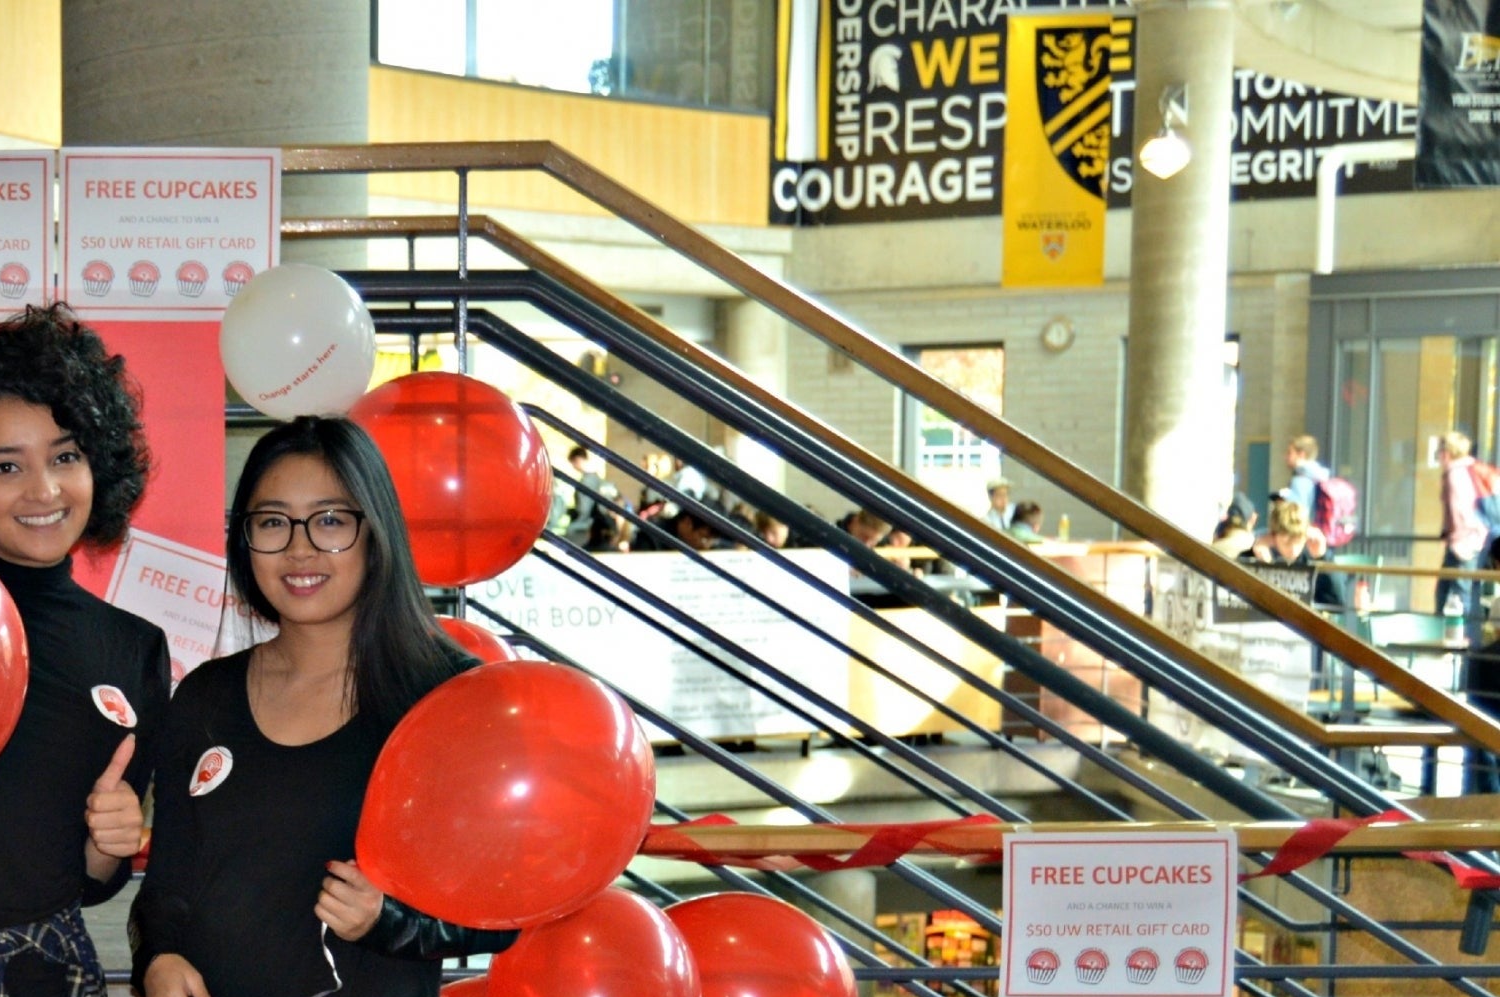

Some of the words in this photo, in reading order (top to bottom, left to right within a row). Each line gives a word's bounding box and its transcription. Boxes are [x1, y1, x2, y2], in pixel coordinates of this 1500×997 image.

[910, 33, 1000, 89] WE
[865, 92, 1008, 156] RESP
[85, 180, 136, 199] FREE
[143, 180, 257, 199] CUPCAKES
[773, 156, 995, 212] COURAGE
[80, 235, 106, 250] $50
[109, 236, 134, 249] UW
[137, 236, 182, 249] RETAIL
[185, 237, 215, 249] GIFT
[219, 237, 256, 250] CARD
[258, 385, 292, 402] Change
[293, 364, 318, 387] starts
[317, 342, 338, 365] here.
[139, 566, 190, 598] FREE
[551, 607, 618, 628] BODY
[1031, 866, 1085, 885] FREE
[1092, 865, 1212, 885] CUPCAKES
[1026, 923, 1052, 937] $50
[1056, 924, 1082, 936] UW
[1086, 923, 1132, 936] RETAIL
[1136, 923, 1168, 936] GIFT
[1172, 923, 1210, 936] CARD
